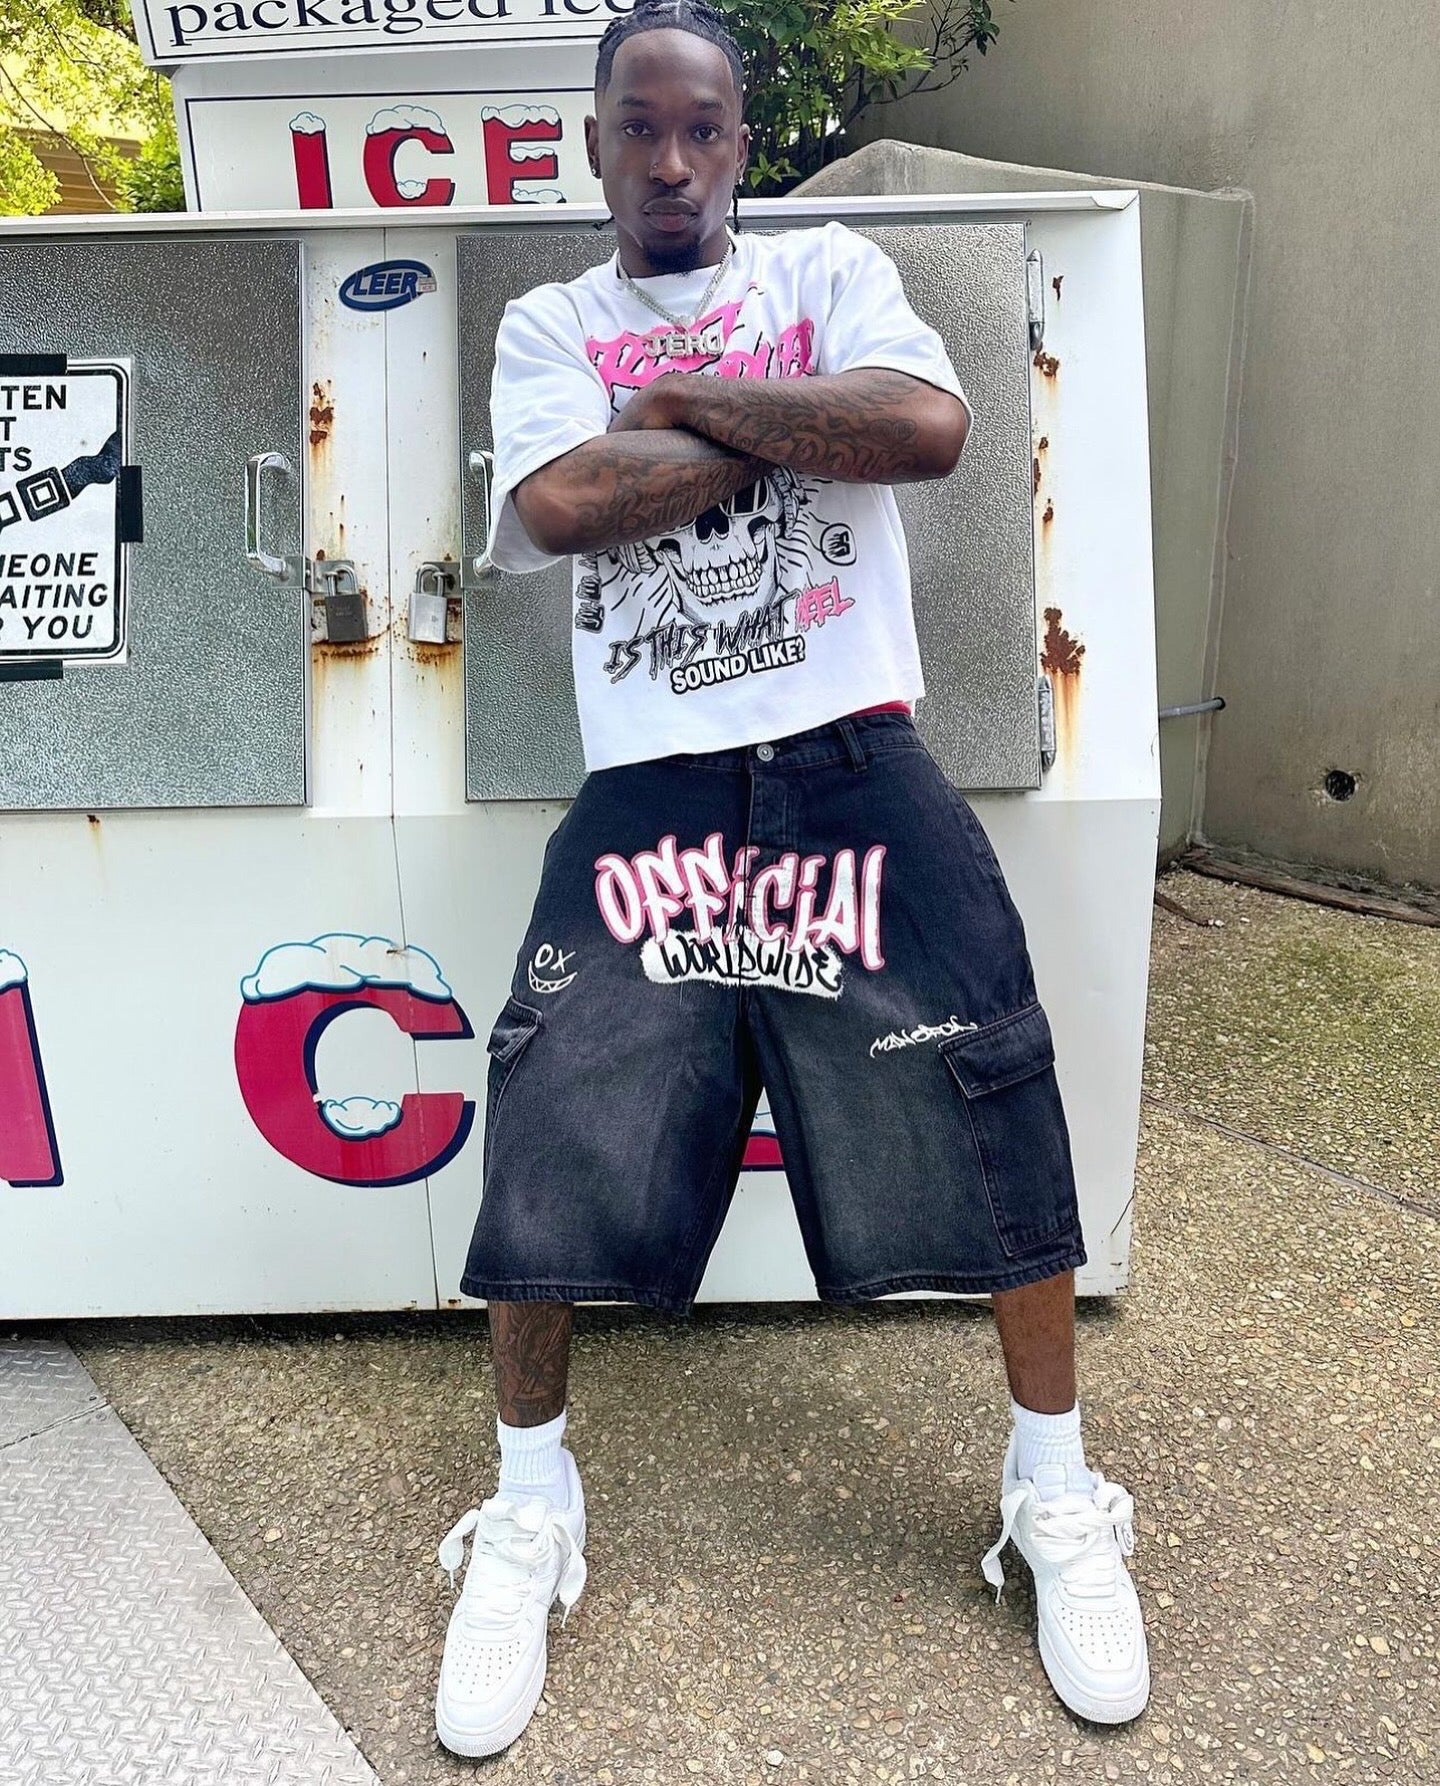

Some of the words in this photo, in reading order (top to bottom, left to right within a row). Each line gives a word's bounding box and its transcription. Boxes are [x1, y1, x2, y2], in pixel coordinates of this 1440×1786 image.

[290, 104, 567, 210] ICE
[352, 270, 418, 300] LEER
[0, 385, 67, 410] TEN
[0, 552, 98, 578] EONE
[22, 615, 93, 640] YOU
[603, 635, 644, 684] IS
[643, 619, 711, 681] THIS
[713, 589, 801, 656] WHAT
[671, 655, 748, 694] SOUND
[750, 634, 806, 674] LIKE?
